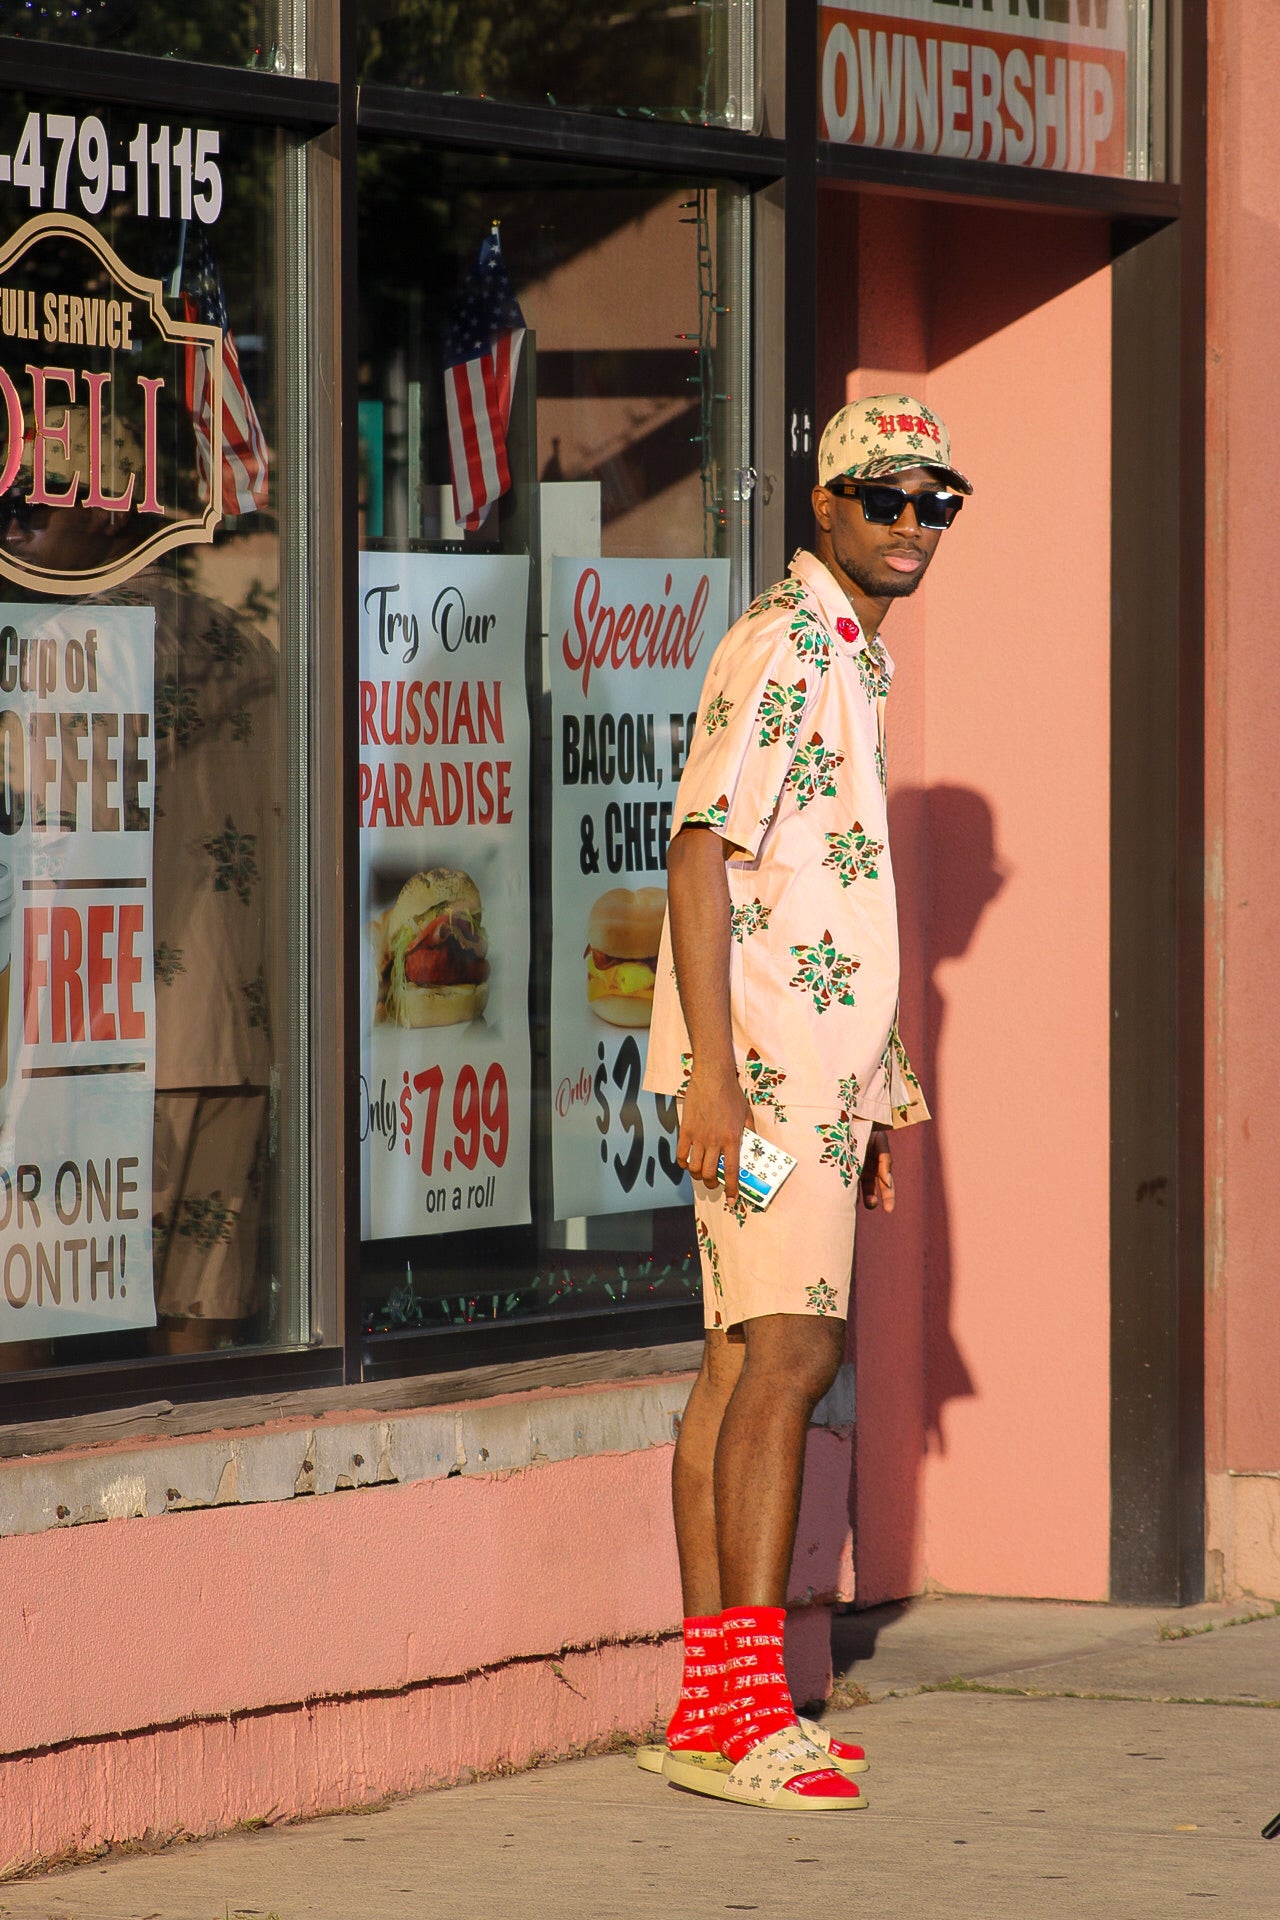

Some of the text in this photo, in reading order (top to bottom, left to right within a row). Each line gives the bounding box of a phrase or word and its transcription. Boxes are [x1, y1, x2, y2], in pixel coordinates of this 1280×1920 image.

[822, 22, 1114, 174] OWNERSHIP
[0, 288, 133, 350] ULL SERVICE
[364, 583, 496, 664] Try Our
[562, 567, 710, 699] Special
[0, 626, 98, 699] Cup of
[359, 680, 505, 745] RUSSIAN
[562, 713, 663, 791] BACON,
[359, 761, 513, 828] PARADISE
[580, 814, 600, 875] &
[23, 904, 146, 1045] FREE
[400, 1062, 509, 1176] $7.99
[555, 1067, 592, 1117] Only
[55, 1157, 139, 1226] ONE
[426, 1175, 496, 1213] on a roll
